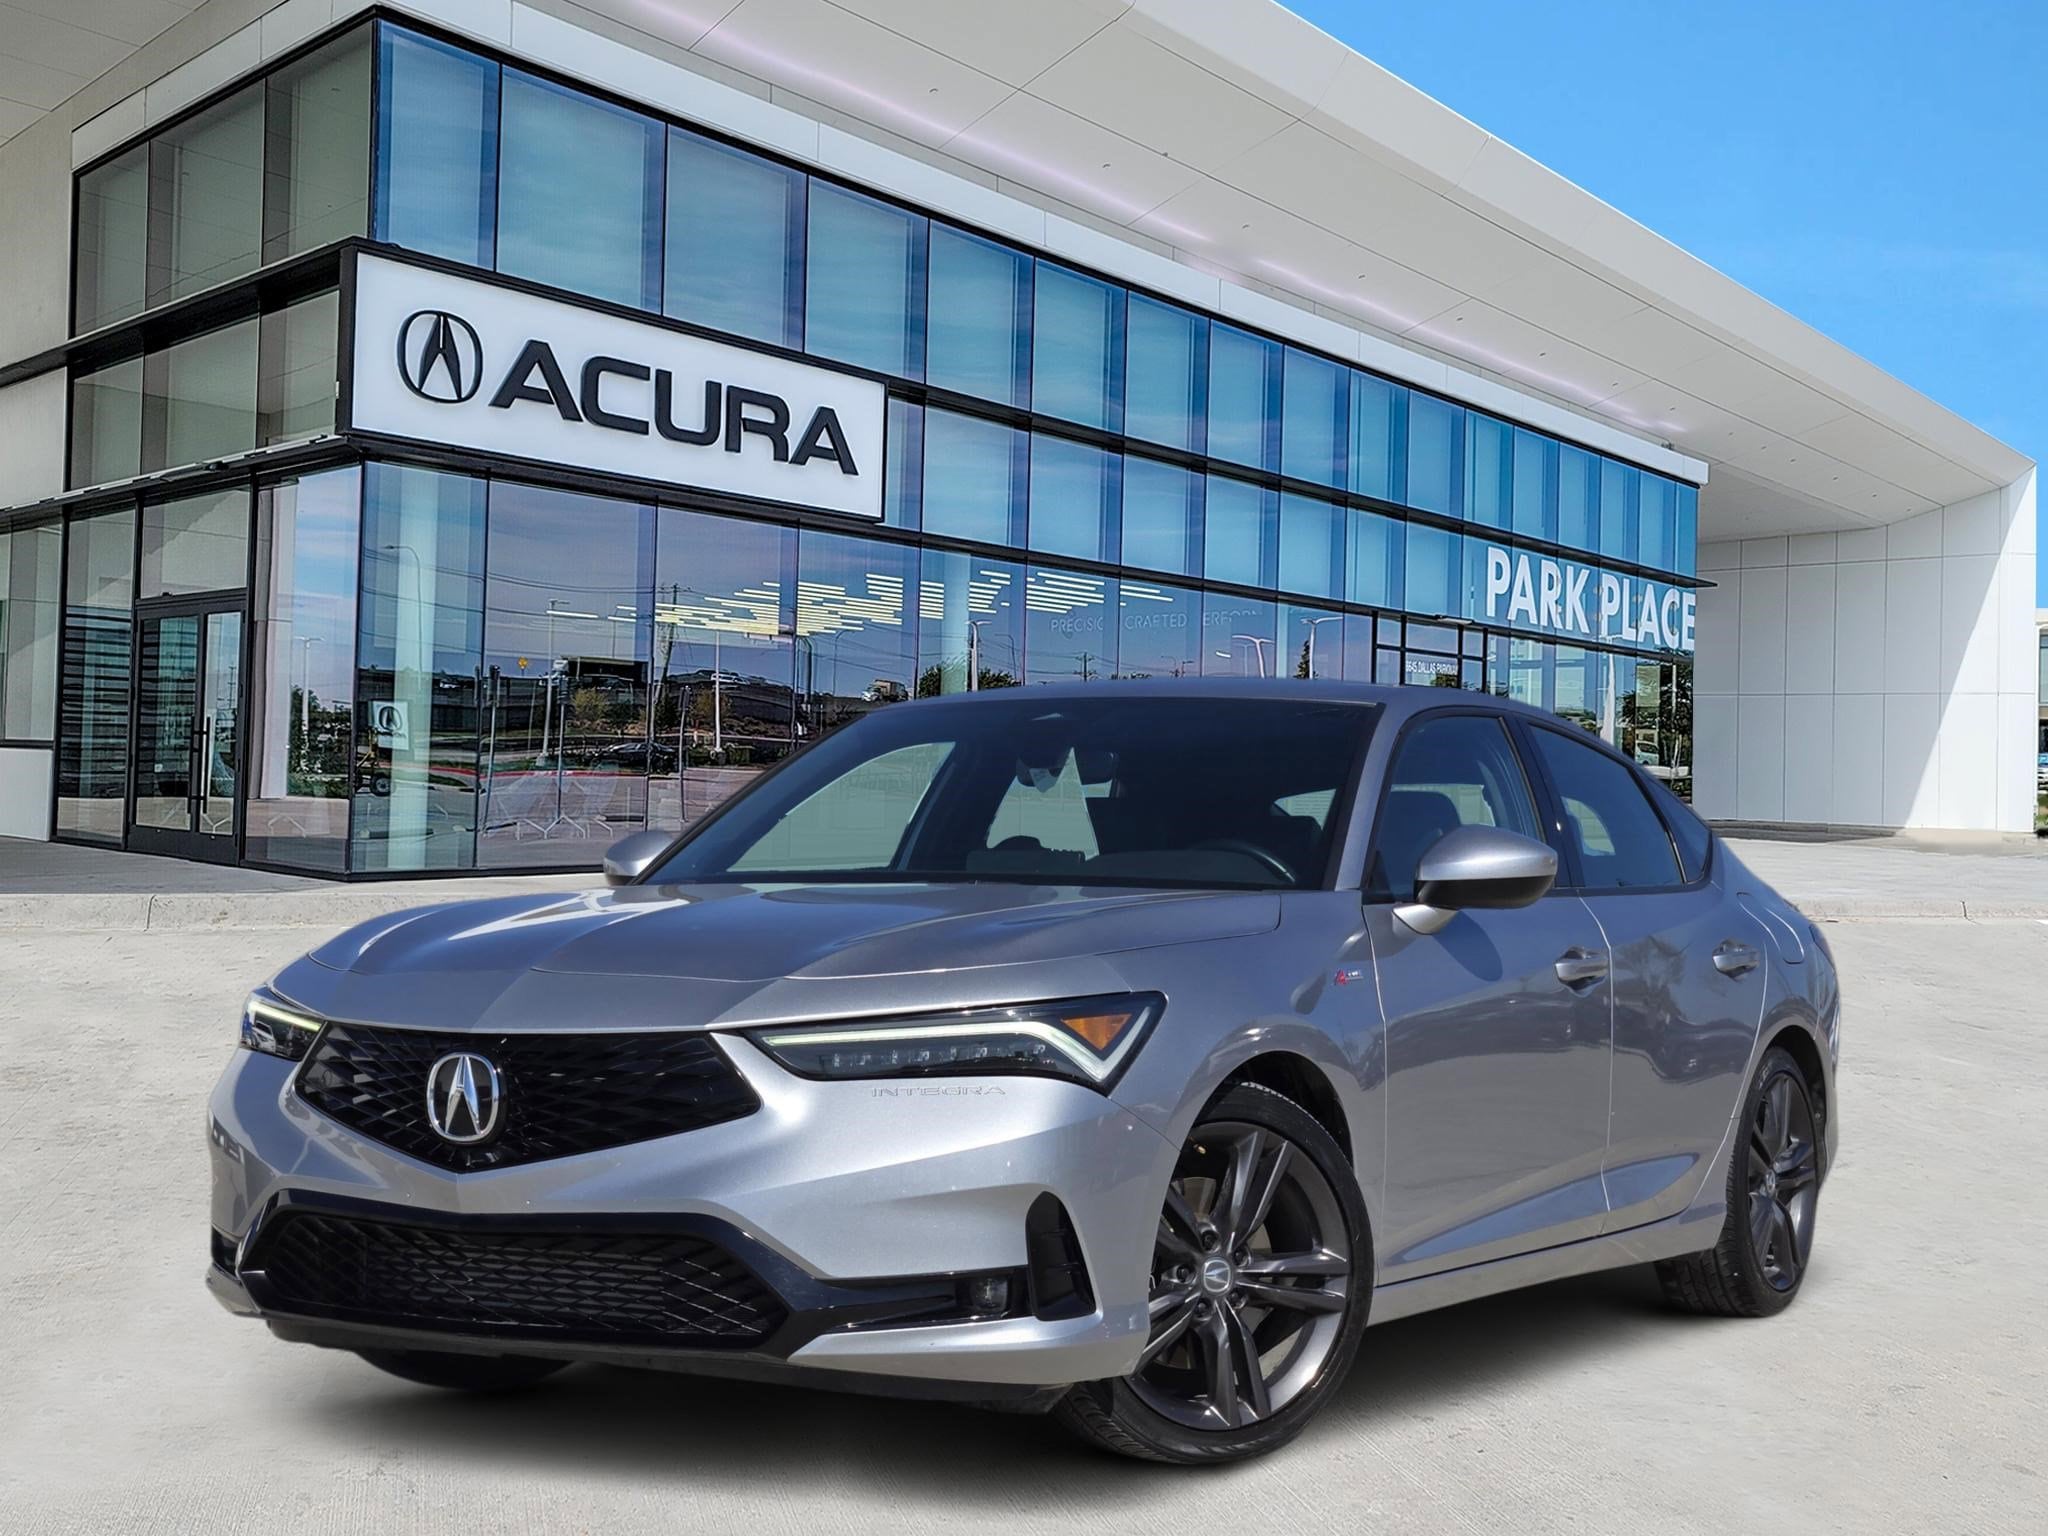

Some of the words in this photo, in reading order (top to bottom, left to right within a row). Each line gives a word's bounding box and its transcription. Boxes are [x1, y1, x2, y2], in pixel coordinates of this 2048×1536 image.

[488, 339, 859, 476] ACURA
[1124, 613, 1188, 630] CRAFTED
[1486, 546, 1591, 634] PARK
[1600, 571, 1696, 651] PLACE
[871, 1085, 1006, 1098] INTEGRA
